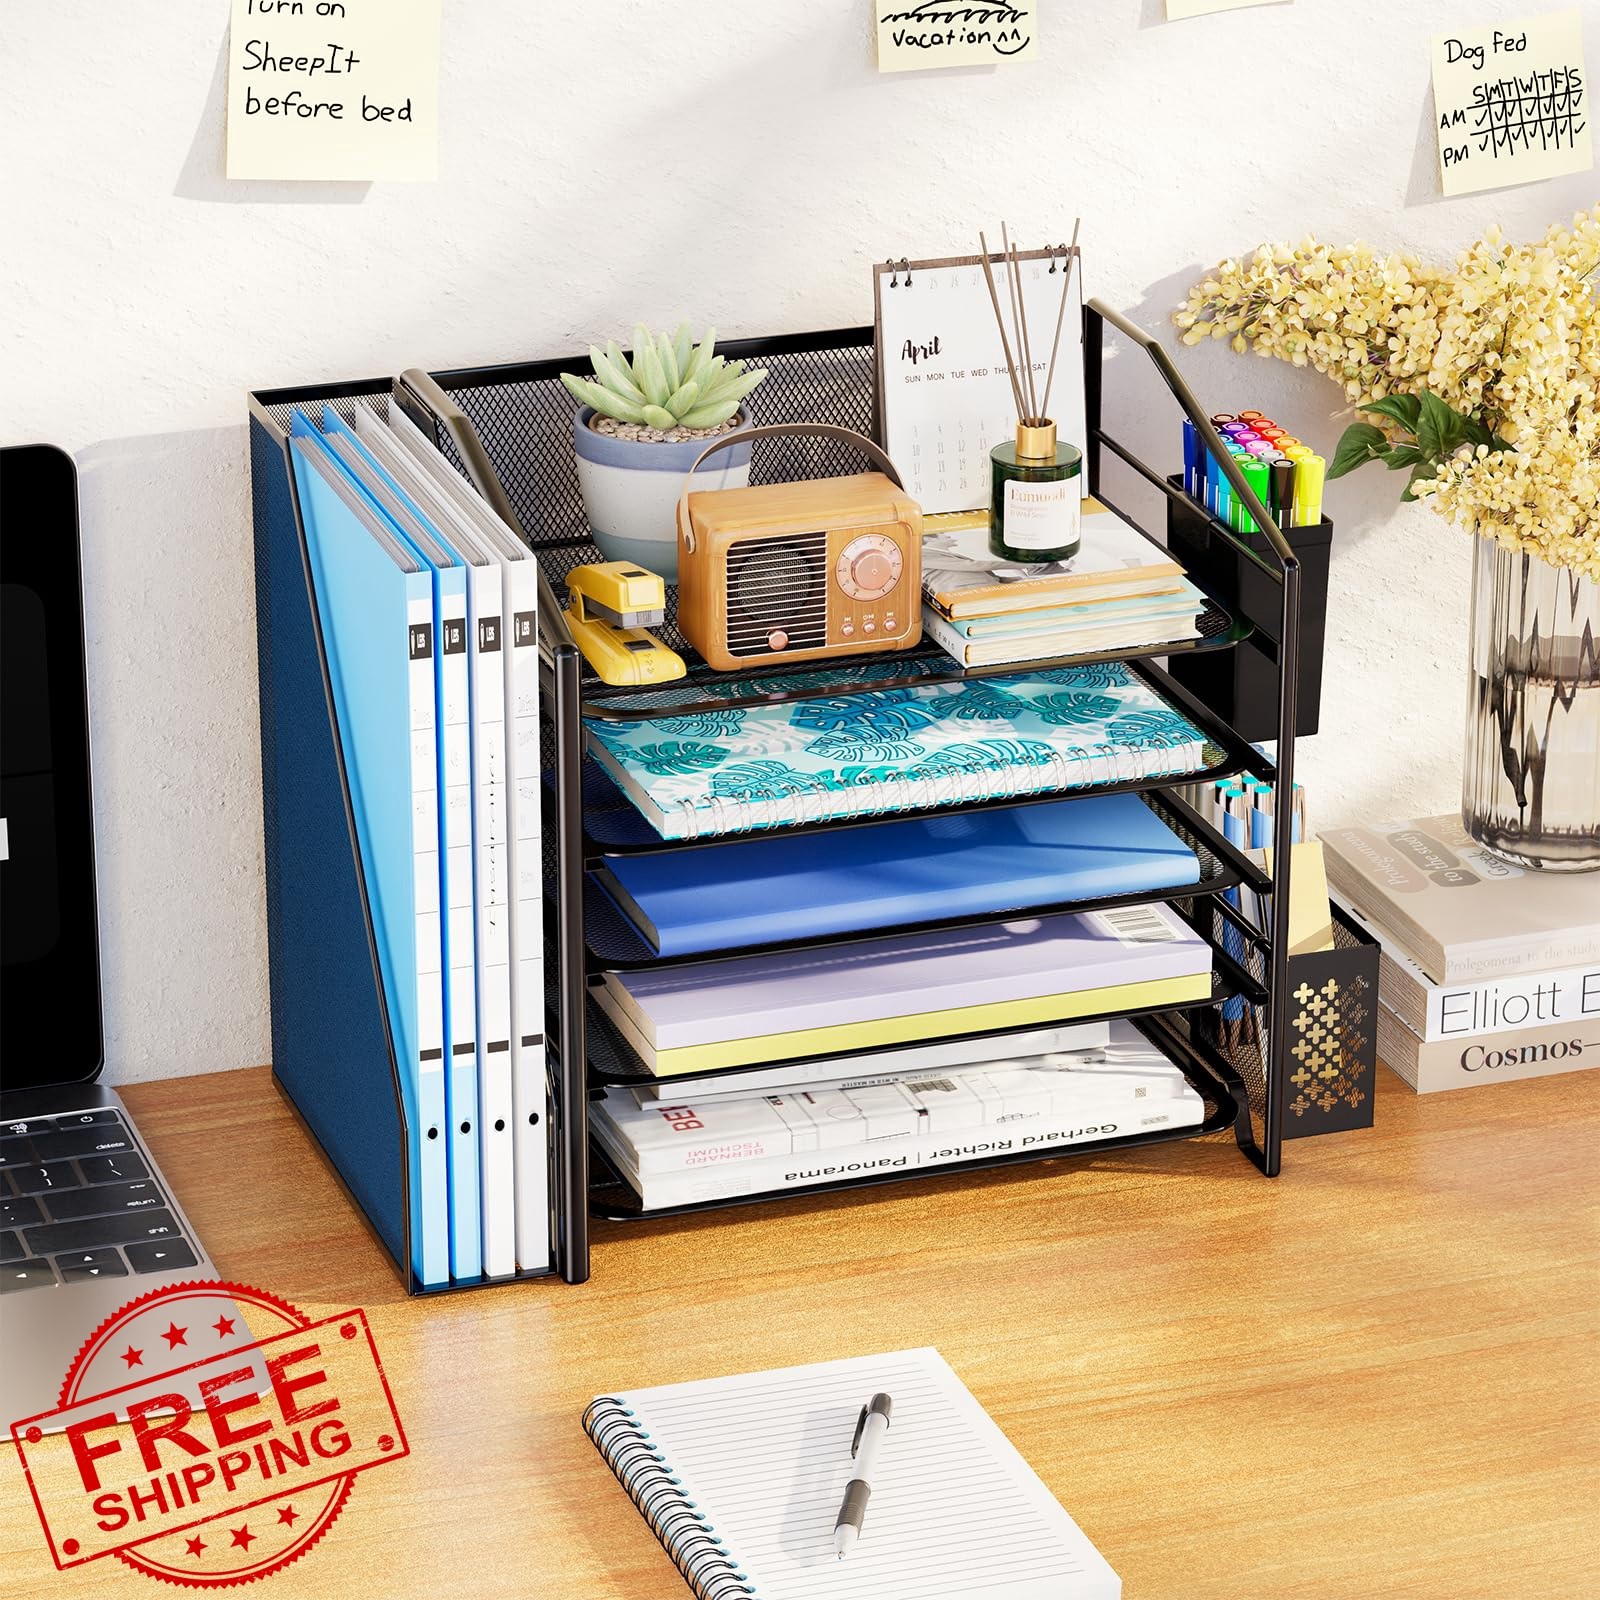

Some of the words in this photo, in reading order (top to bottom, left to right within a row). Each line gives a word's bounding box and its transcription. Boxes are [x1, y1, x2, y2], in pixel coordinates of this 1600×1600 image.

[315, 2, 346, 18] on
[892, 27, 991, 48] Vacation
[1443, 38, 1485, 70] Dog
[245, 86, 344, 119] before
[361, 94, 413, 122] bed
[1440, 109, 1467, 130] AM
[1443, 144, 1469, 168] PM
[901, 335, 943, 365] April
[904, 374, 922, 384] SUN
[926, 372, 946, 382] MON
[951, 370, 966, 380] TUE
[971, 368, 988, 378] WED
[1031, 362, 1047, 372] SAT
[1424, 854, 1449, 870] the
[1444, 871, 1464, 882] to
[1445, 953, 1522, 975] Prolegomena
[1527, 950, 1539, 962] to
[1544, 944, 1562, 960] the
[1441, 982, 1562, 1034] Elliott
[1021, 1123, 1118, 1148] Gerhard
[685, 1147, 765, 1165] BERNARD
[688, 1141, 763, 1159] TSCHUMI
[929, 1139, 1013, 1159] Richter
[784, 1155, 907, 1182] Panorama
